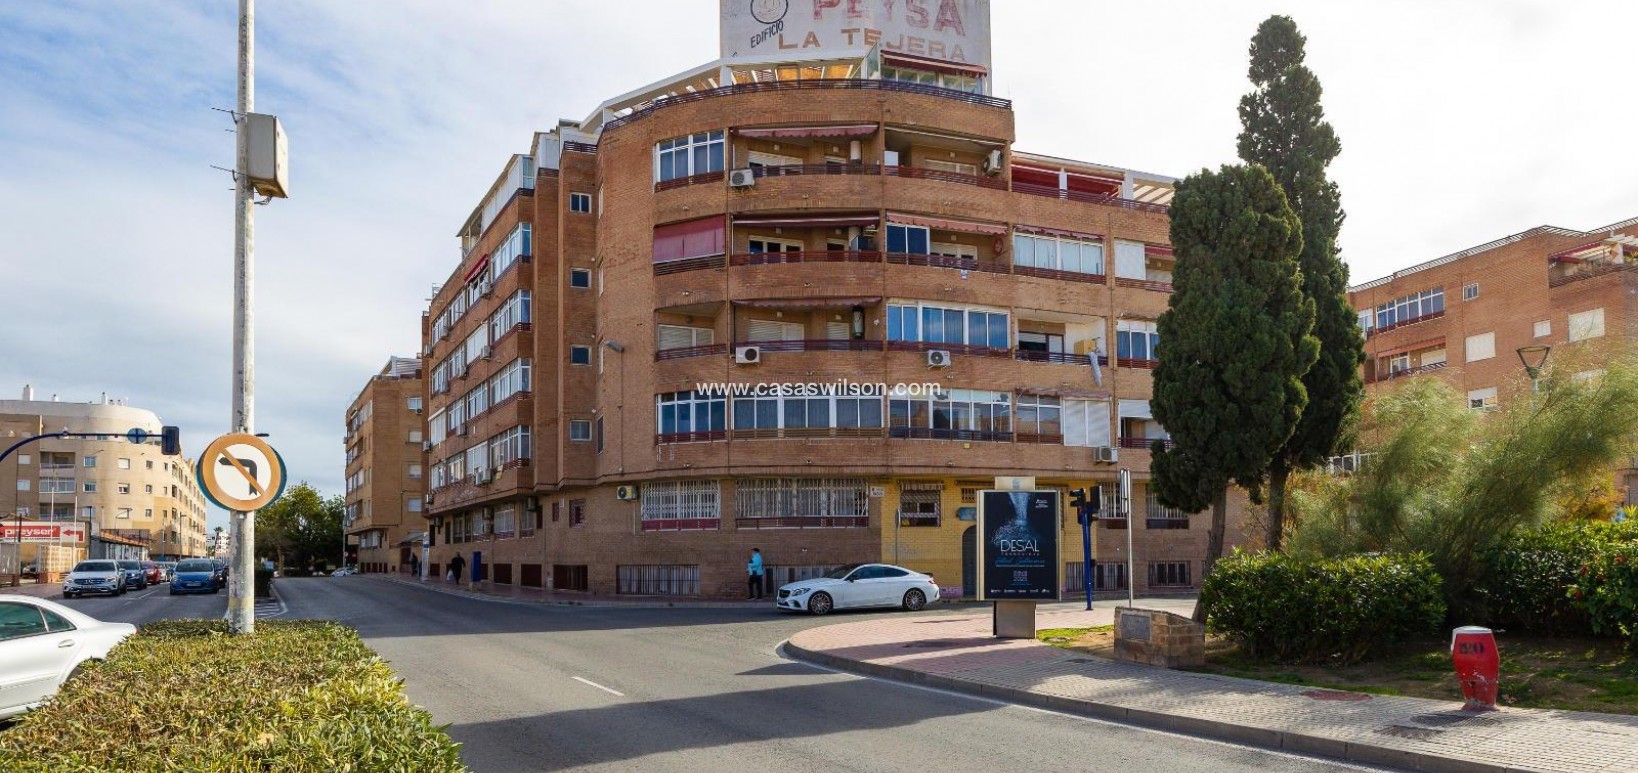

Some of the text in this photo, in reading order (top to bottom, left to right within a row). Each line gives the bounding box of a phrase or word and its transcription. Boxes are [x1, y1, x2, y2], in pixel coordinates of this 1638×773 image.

[750, 20, 784, 49] EDIFICIO
[778, 27, 966, 61] LA TEJERA
[1000, 539, 1040, 552] DESAL
